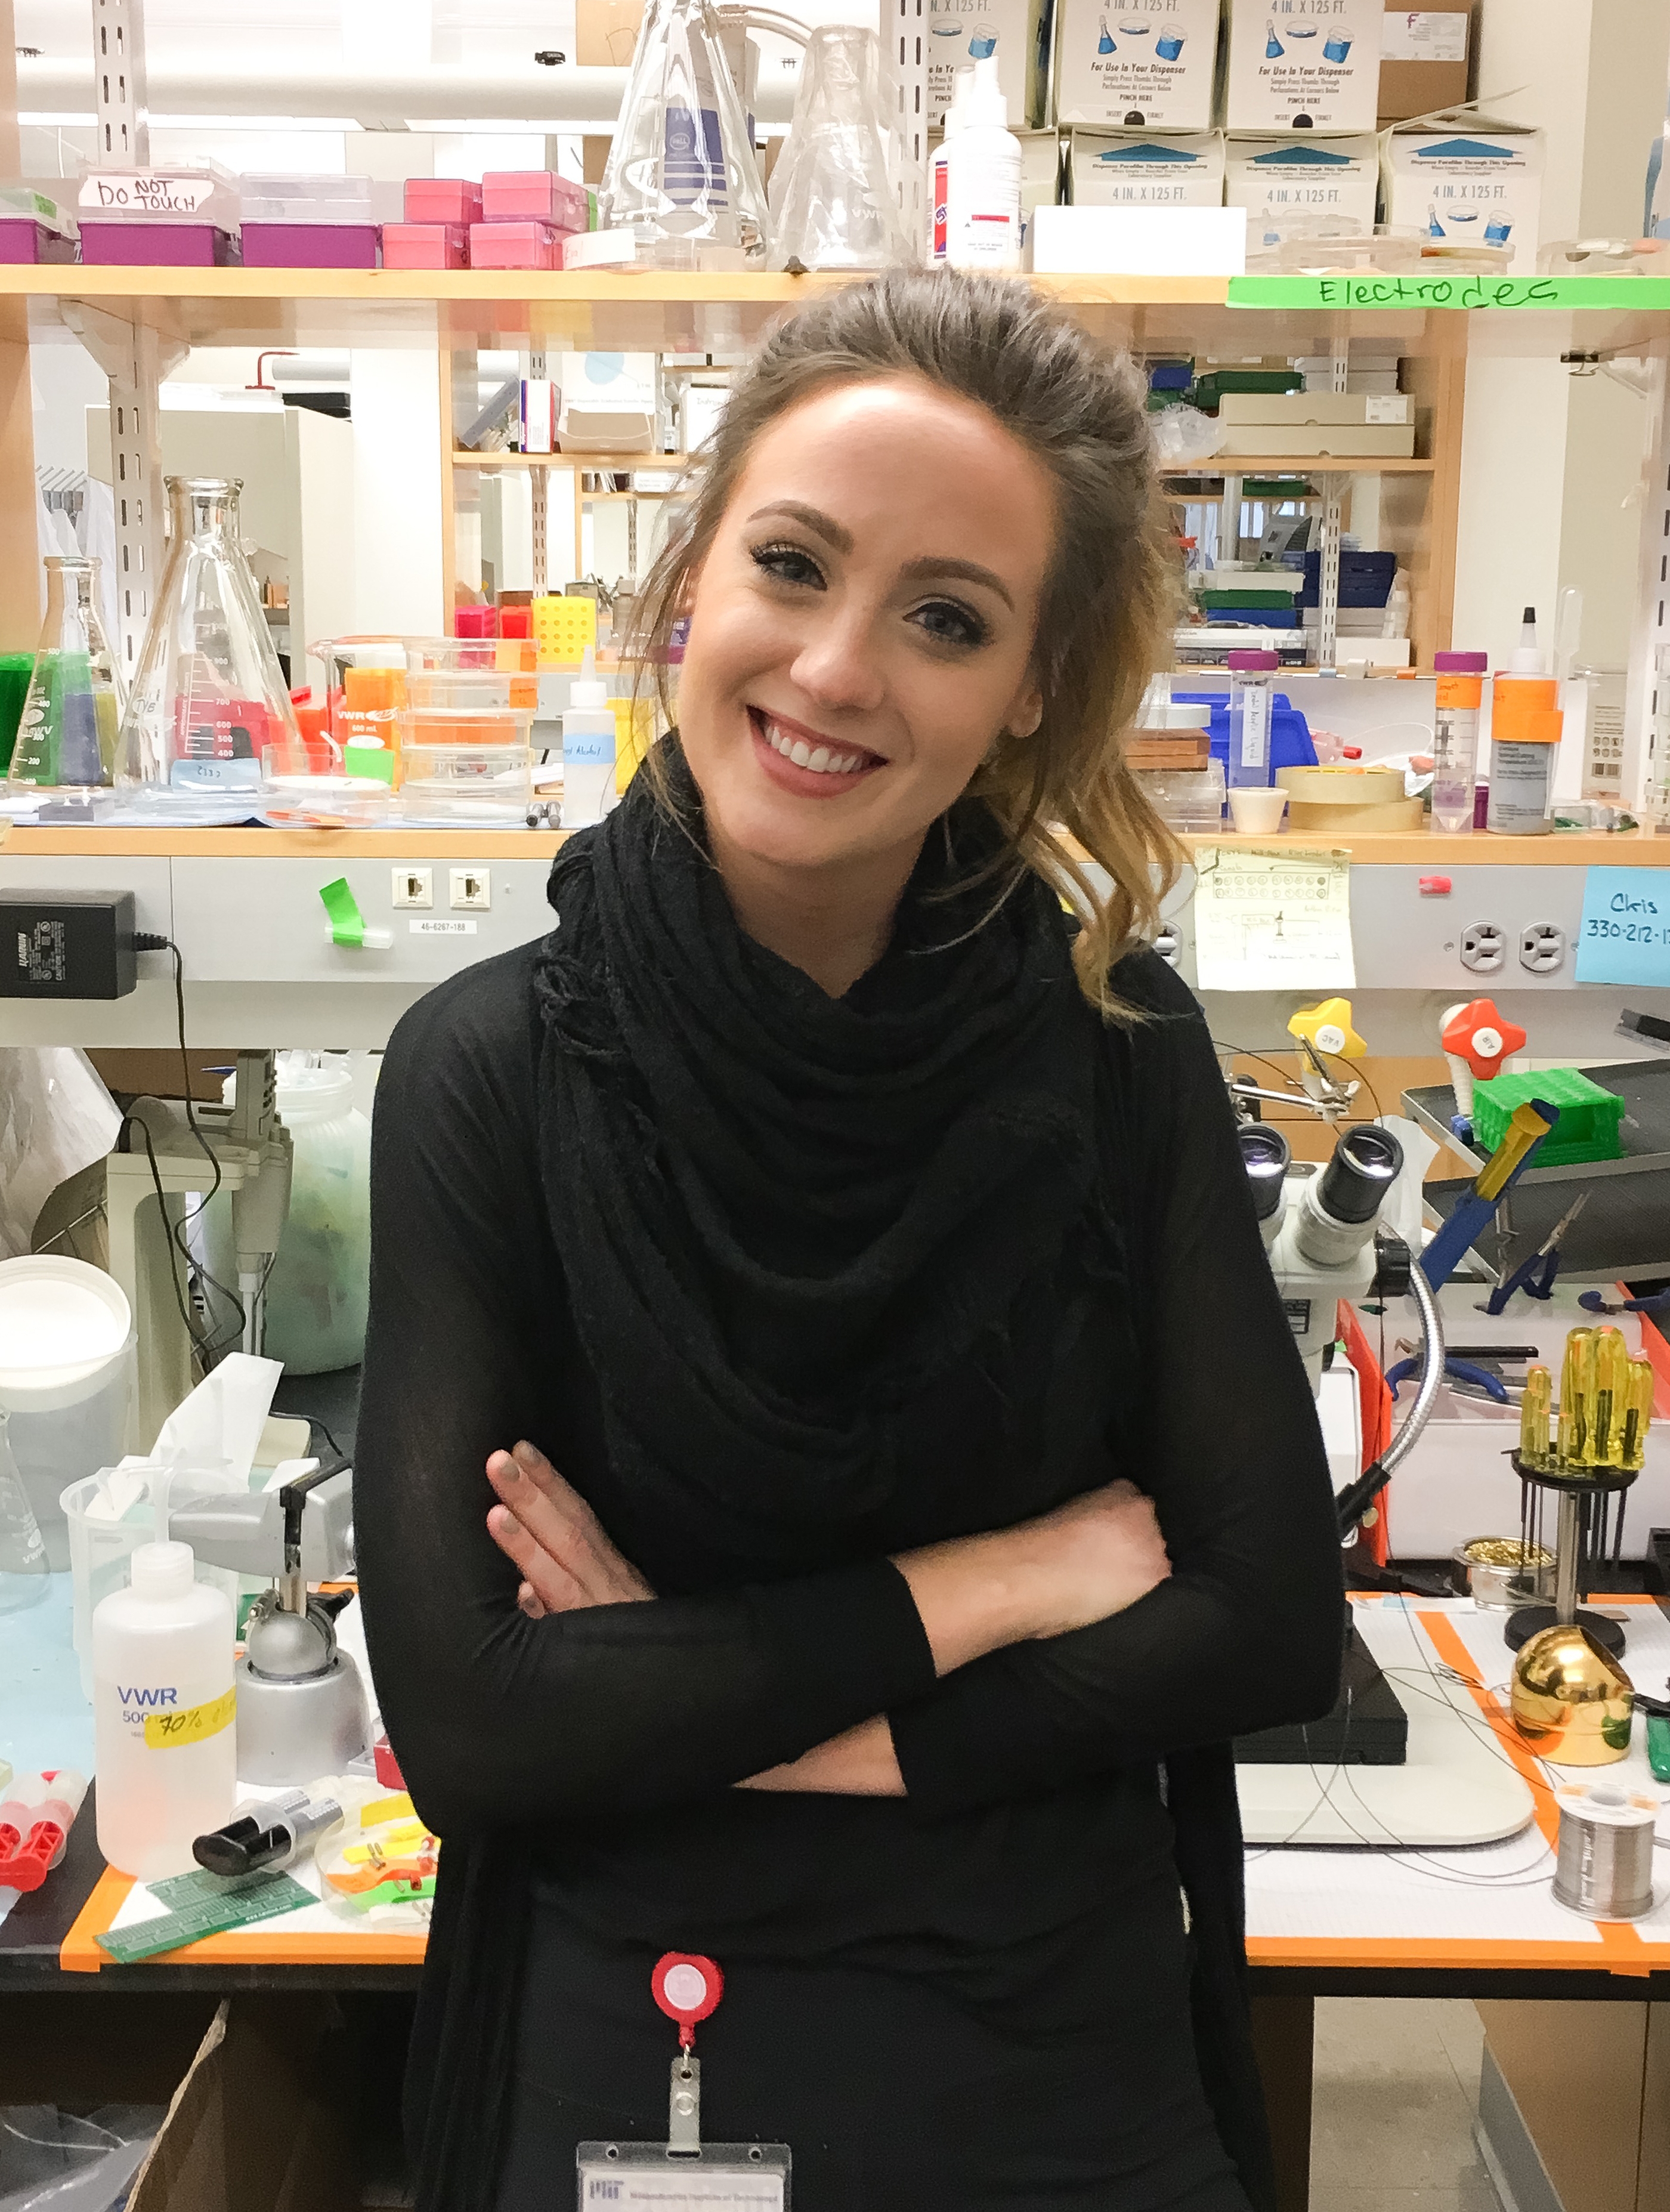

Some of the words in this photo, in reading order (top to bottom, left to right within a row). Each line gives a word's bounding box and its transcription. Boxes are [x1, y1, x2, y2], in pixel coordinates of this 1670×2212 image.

[945, 0, 951, 11] X
[957, 0, 973, 11] 125
[978, 0, 991, 11] FT.
[1104, 0, 1110, 9] 4
[1114, 0, 1128, 10] IN.
[1133, 0, 1139, 10] X
[1144, 0, 1162, 11] 125
[1167, 0, 1180, 12] FT.
[1271, 1, 1277, 13] 4
[1282, 1, 1295, 13] IN.
[1300, 1, 1306, 13] X
[1311, 1, 1329, 14] 125
[1333, 1, 1347, 14] FT.
[1091, 62, 1103, 71] For
[1105, 63, 1119, 72] Use
[1121, 63, 1128, 72] In
[1132, 63, 1148, 73] Your
[1150, 64, 1186, 75] Dispenser
[1258, 66, 1271, 75] For
[1273, 66, 1286, 75] Use
[1289, 67, 1296, 75] In
[1300, 67, 1316, 75] Your
[1318, 67, 1354, 78] Dispenser
[135, 179, 175, 196] NOT
[1112, 187, 1118, 200] 4
[1122, 187, 1136, 200] IN.
[1140, 187, 1147, 200] X
[1152, 187, 1170, 200] 125
[1173, 187, 1187, 200] FT.
[1433, 185, 1439, 198] 4
[1443, 185, 1456, 198] IN.
[1460, 185, 1467, 198] X
[1472, 185, 1490, 198] 125
[1493, 185, 1507, 198] FT.
[1267, 189, 1273, 202] 4
[1278, 189, 1291, 202] IN.
[1295, 189, 1301, 202] X
[1306, 189, 1325, 202] 125
[1328, 189, 1341, 202] FT.
[134, 195, 195, 211] TOUCH
[336, 710, 366, 721] VWR
[216, 721, 232, 729] 600
[217, 734, 233, 743] 500
[27, 757, 41, 765] 200
[421, 922, 466, 931] 46-6267-188
[1321, 1034, 1340, 1048] VAC
[1482, 1036, 1495, 1050] AIR
[117, 1685, 178, 1706] VWR
[159, 1710, 202, 1736] 70%
